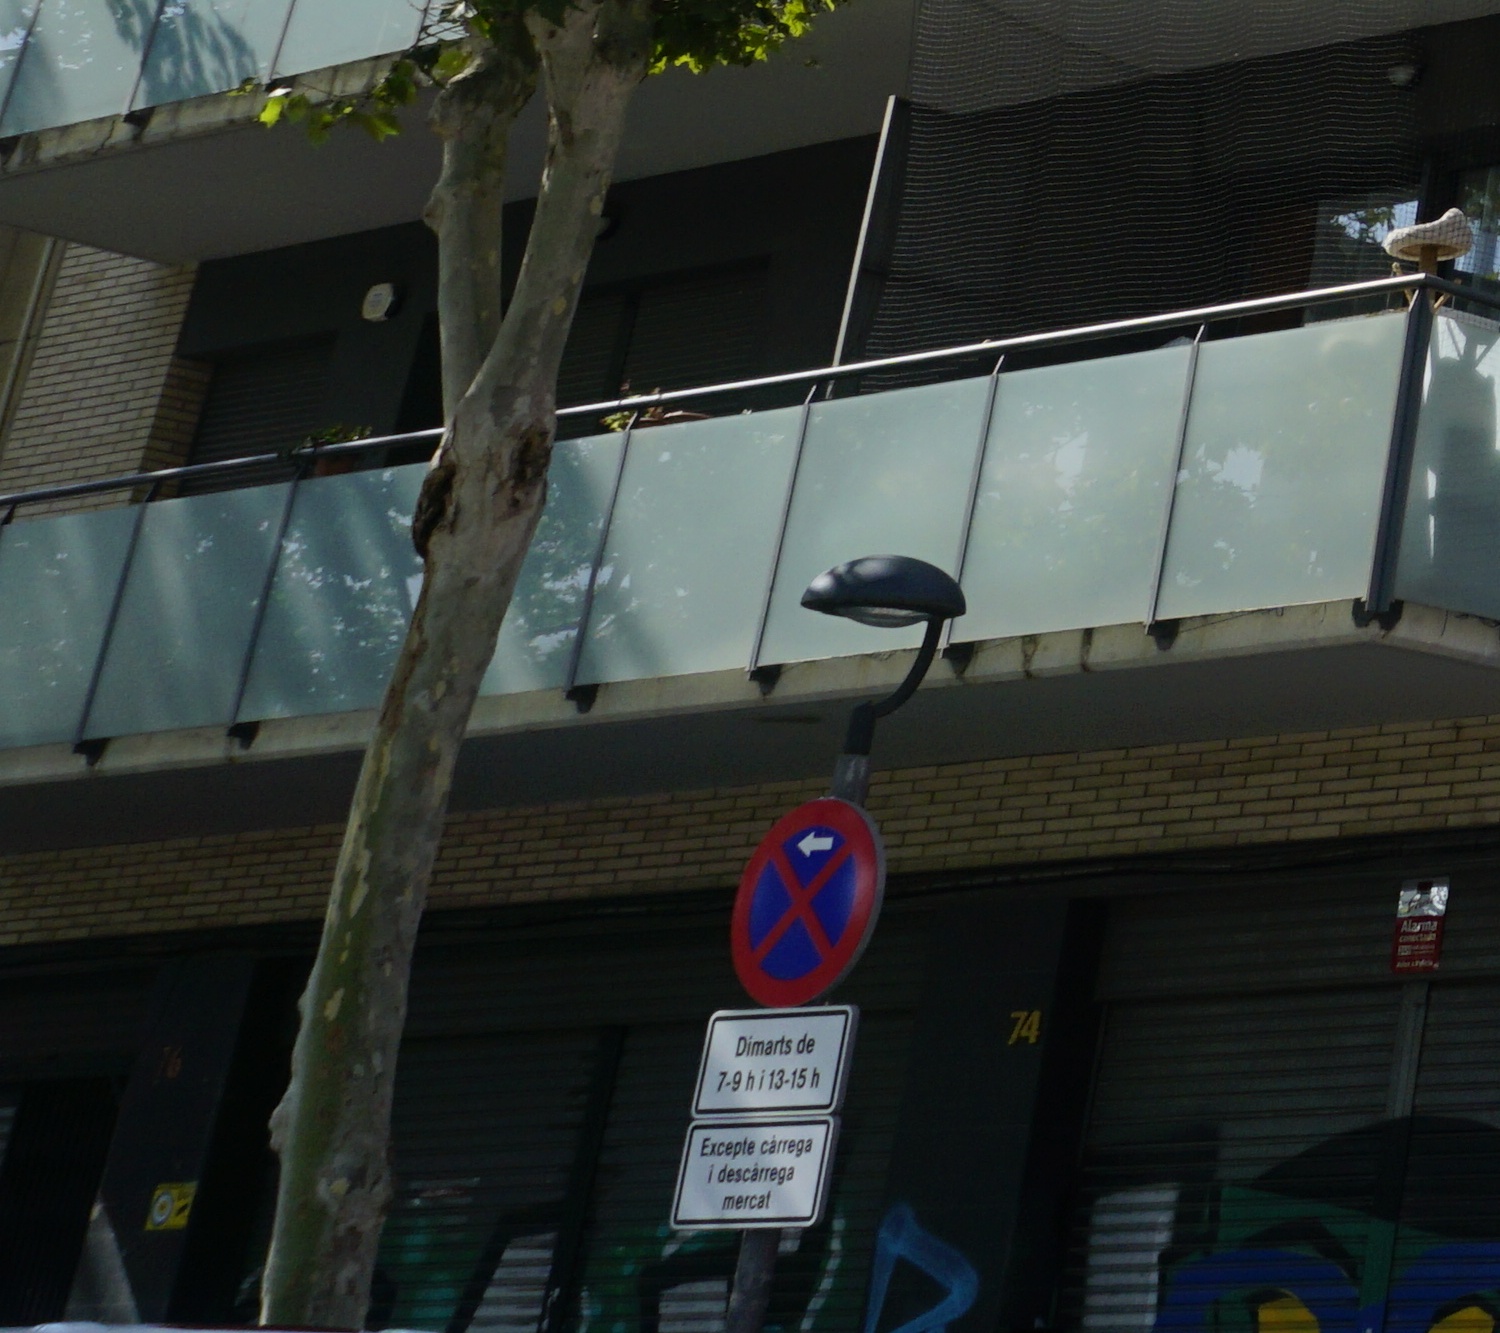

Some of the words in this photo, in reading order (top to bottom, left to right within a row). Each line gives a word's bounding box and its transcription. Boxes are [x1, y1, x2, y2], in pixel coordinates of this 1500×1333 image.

[1400, 919, 1438, 933] Alarma
[1007, 1009, 1043, 1045] 74
[735, 1035, 792, 1057] Dimarts
[796, 1033, 816, 1055] de
[716, 1070, 742, 1092] 7-9
[746, 1070, 755, 1092] h
[758, 1069, 766, 1091] i
[769, 1068, 808, 1091] 13-15
[810, 1067, 820, 1089] h
[700, 1136, 755, 1160] Excepte
[707, 1163, 715, 1184] i
[721, 1190, 772, 1211] mercat
